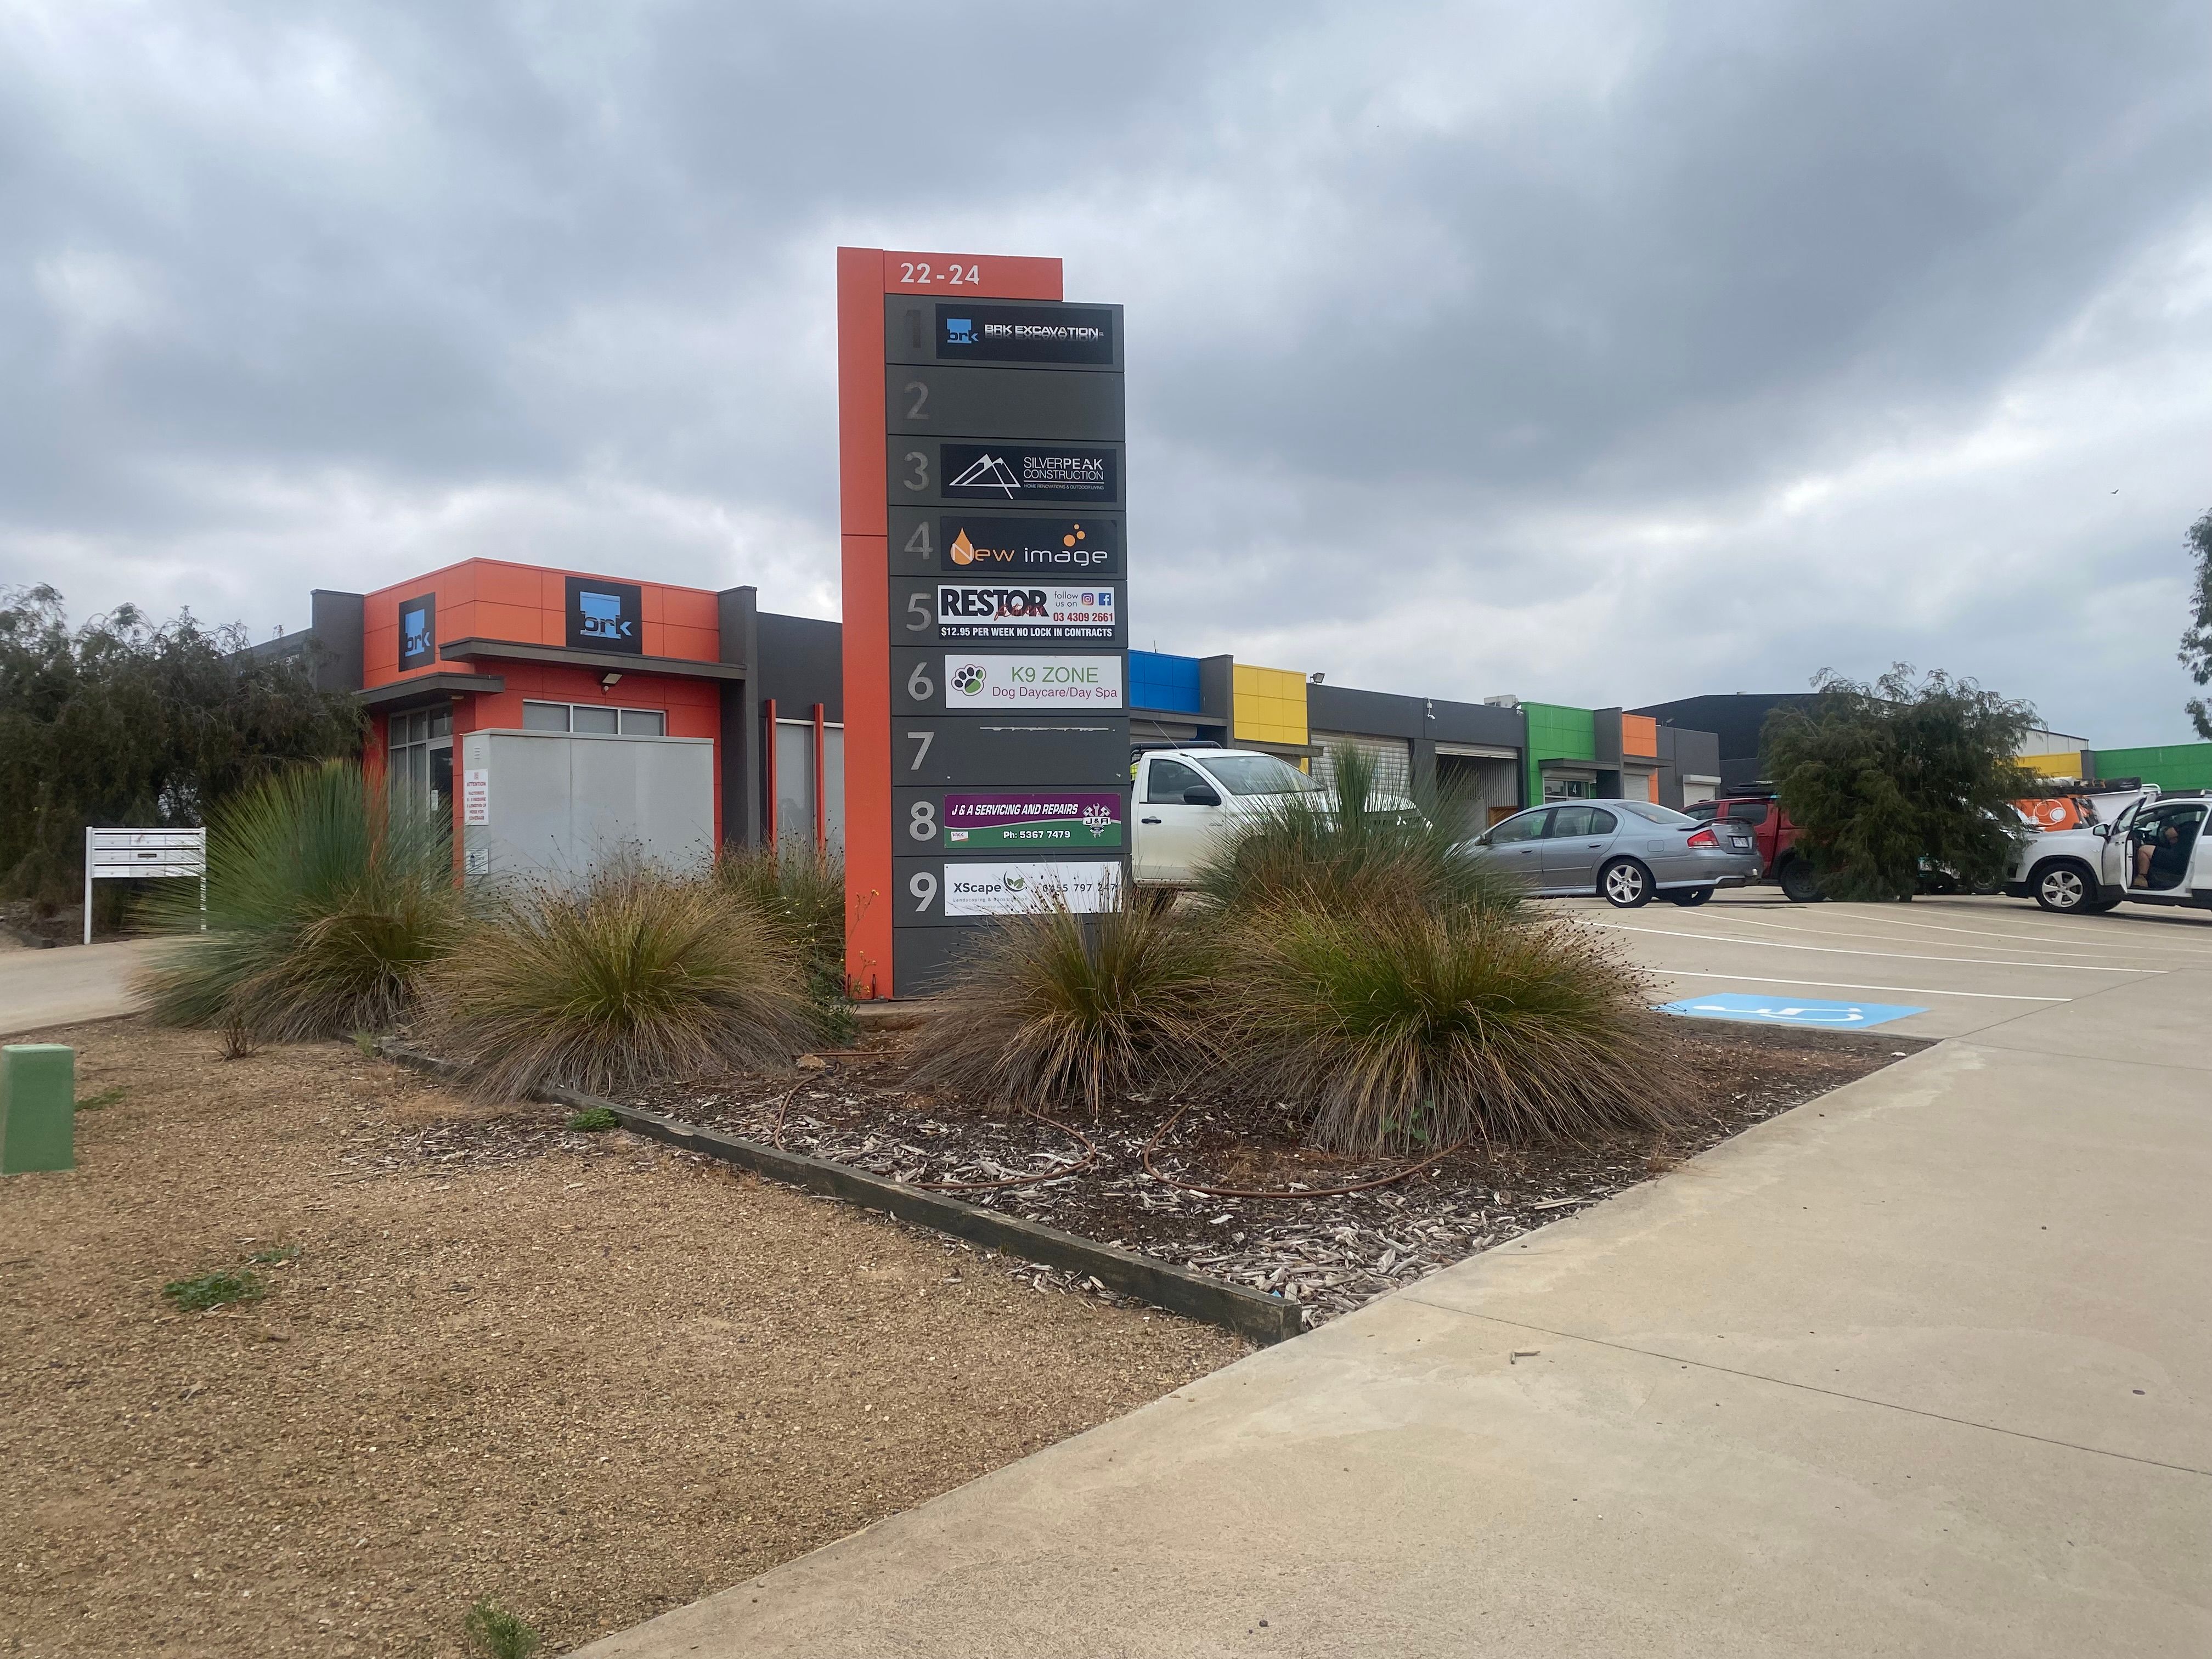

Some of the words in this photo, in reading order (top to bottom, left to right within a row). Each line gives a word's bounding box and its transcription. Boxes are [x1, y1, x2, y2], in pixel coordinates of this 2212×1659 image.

[984, 324, 1013, 334] BRK
[1015, 325, 1098, 336] EXCAVATION
[904, 381, 930, 420] 2
[1024, 456, 1103, 470] SILVERPEAK
[904, 452, 929, 492] 3
[1023, 469, 1104, 481] CONSTRUCTION
[904, 521, 934, 560] 4
[952, 543, 1015, 562] New
[1024, 547, 1108, 567] image
[1054, 591, 1079, 600] follow
[941, 589, 1050, 618] RESTOR
[906, 592, 932, 631] 5
[1053, 612, 1064, 622] 03
[1067, 612, 1090, 622] 4309
[1092, 612, 1114, 622] 2661
[941, 627, 970, 638] $12.95
[973, 628, 989, 636] PER
[991, 628, 1015, 637] WEEK
[1017, 628, 1029, 637] NO
[1030, 628, 1052, 637] LOCK
[1053, 628, 1063, 637] IN
[1064, 628, 1113, 637] CONTRACTS
[908, 662, 934, 701] 6
[1012, 667, 1036, 682] K9
[1042, 667, 1098, 683] ZONE
[992, 686, 1015, 699] Dog
[1019, 687, 1092, 699] Daycare/Day
[1095, 687, 1118, 700] Spa
[907, 731, 935, 770] 7
[1572, 784, 1577, 794] 4
[951, 805, 958, 816] J
[958, 805, 965, 815] &
[966, 805, 973, 816] A
[974, 804, 1021, 816] SERVICING
[1022, 804, 1042, 815] AND
[1042, 803, 1079, 815] REPAIRS
[909, 801, 936, 842] 8
[1003, 831, 1017, 839] Ph:
[1019, 831, 1043, 839] 5367
[909, 872, 938, 912] 9
[953, 883, 1001, 894] XScape
[1073, 884, 1092, 892] 797
